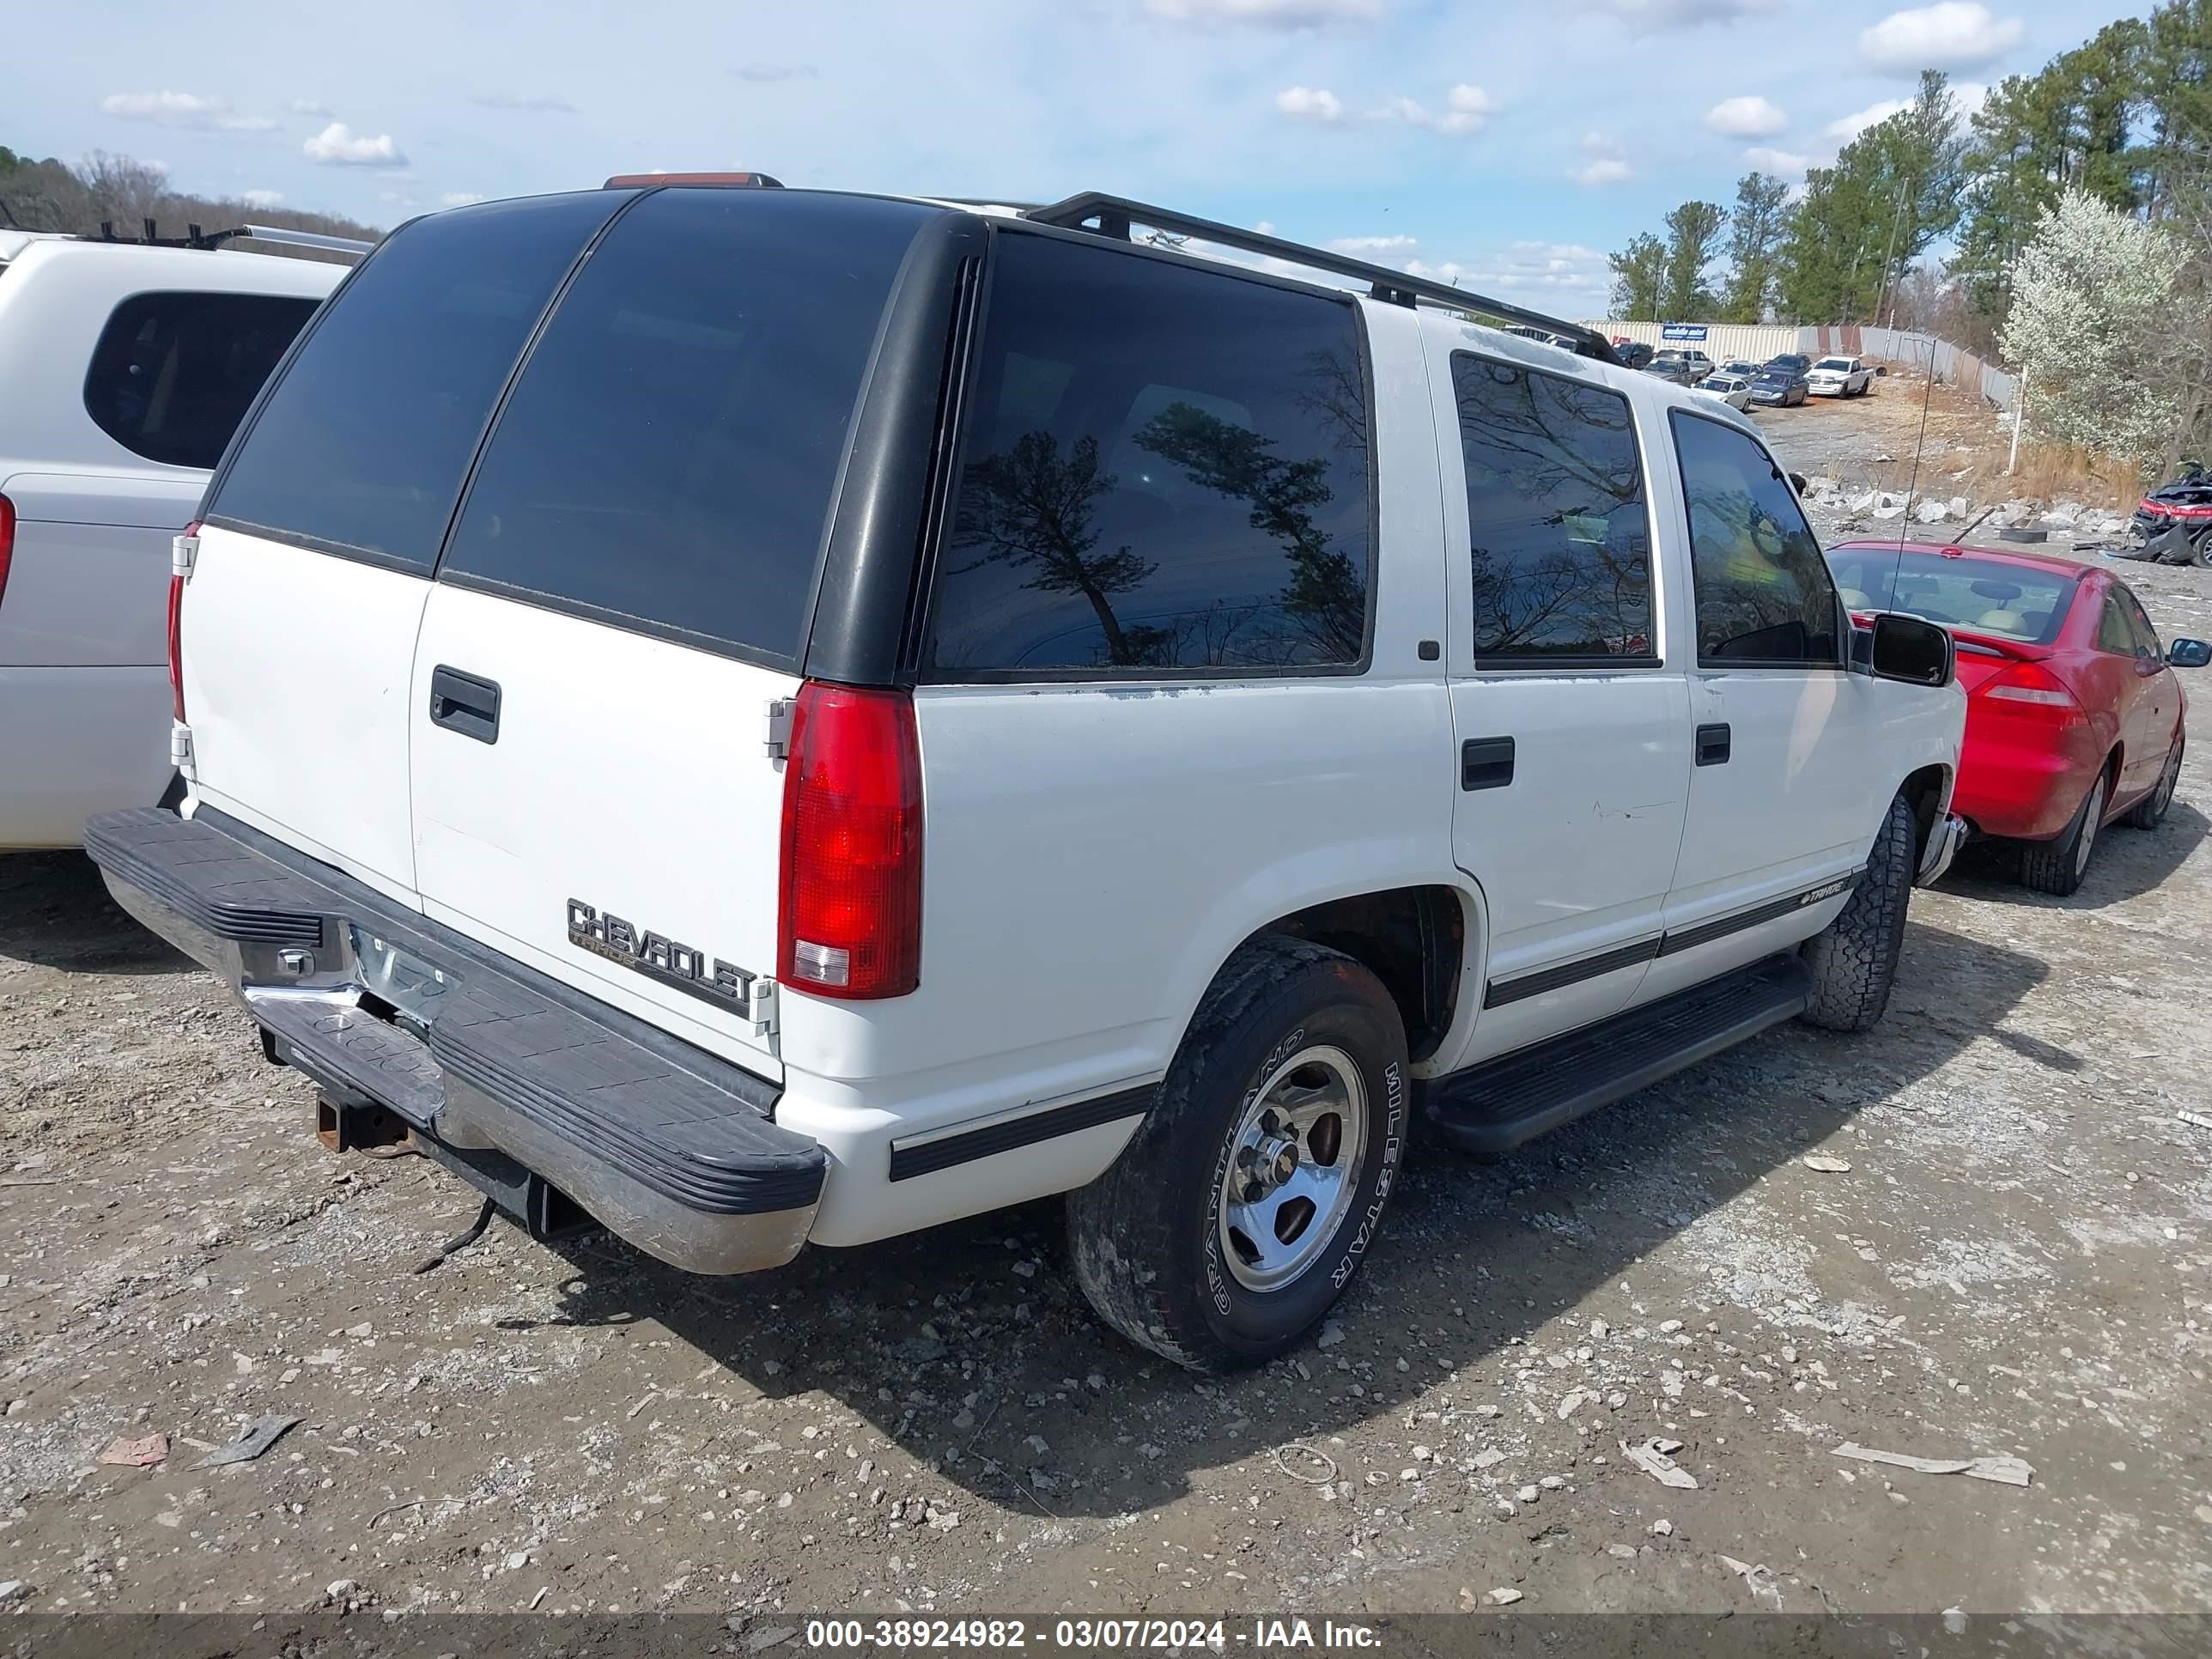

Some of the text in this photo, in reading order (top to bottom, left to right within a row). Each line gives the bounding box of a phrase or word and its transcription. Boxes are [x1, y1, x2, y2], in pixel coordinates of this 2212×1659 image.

[1809, 881, 1844, 901] TAHOE
[567, 897, 757, 1003] CHEVROLET
[1330, 1061, 1401, 1289] MILESTAR
